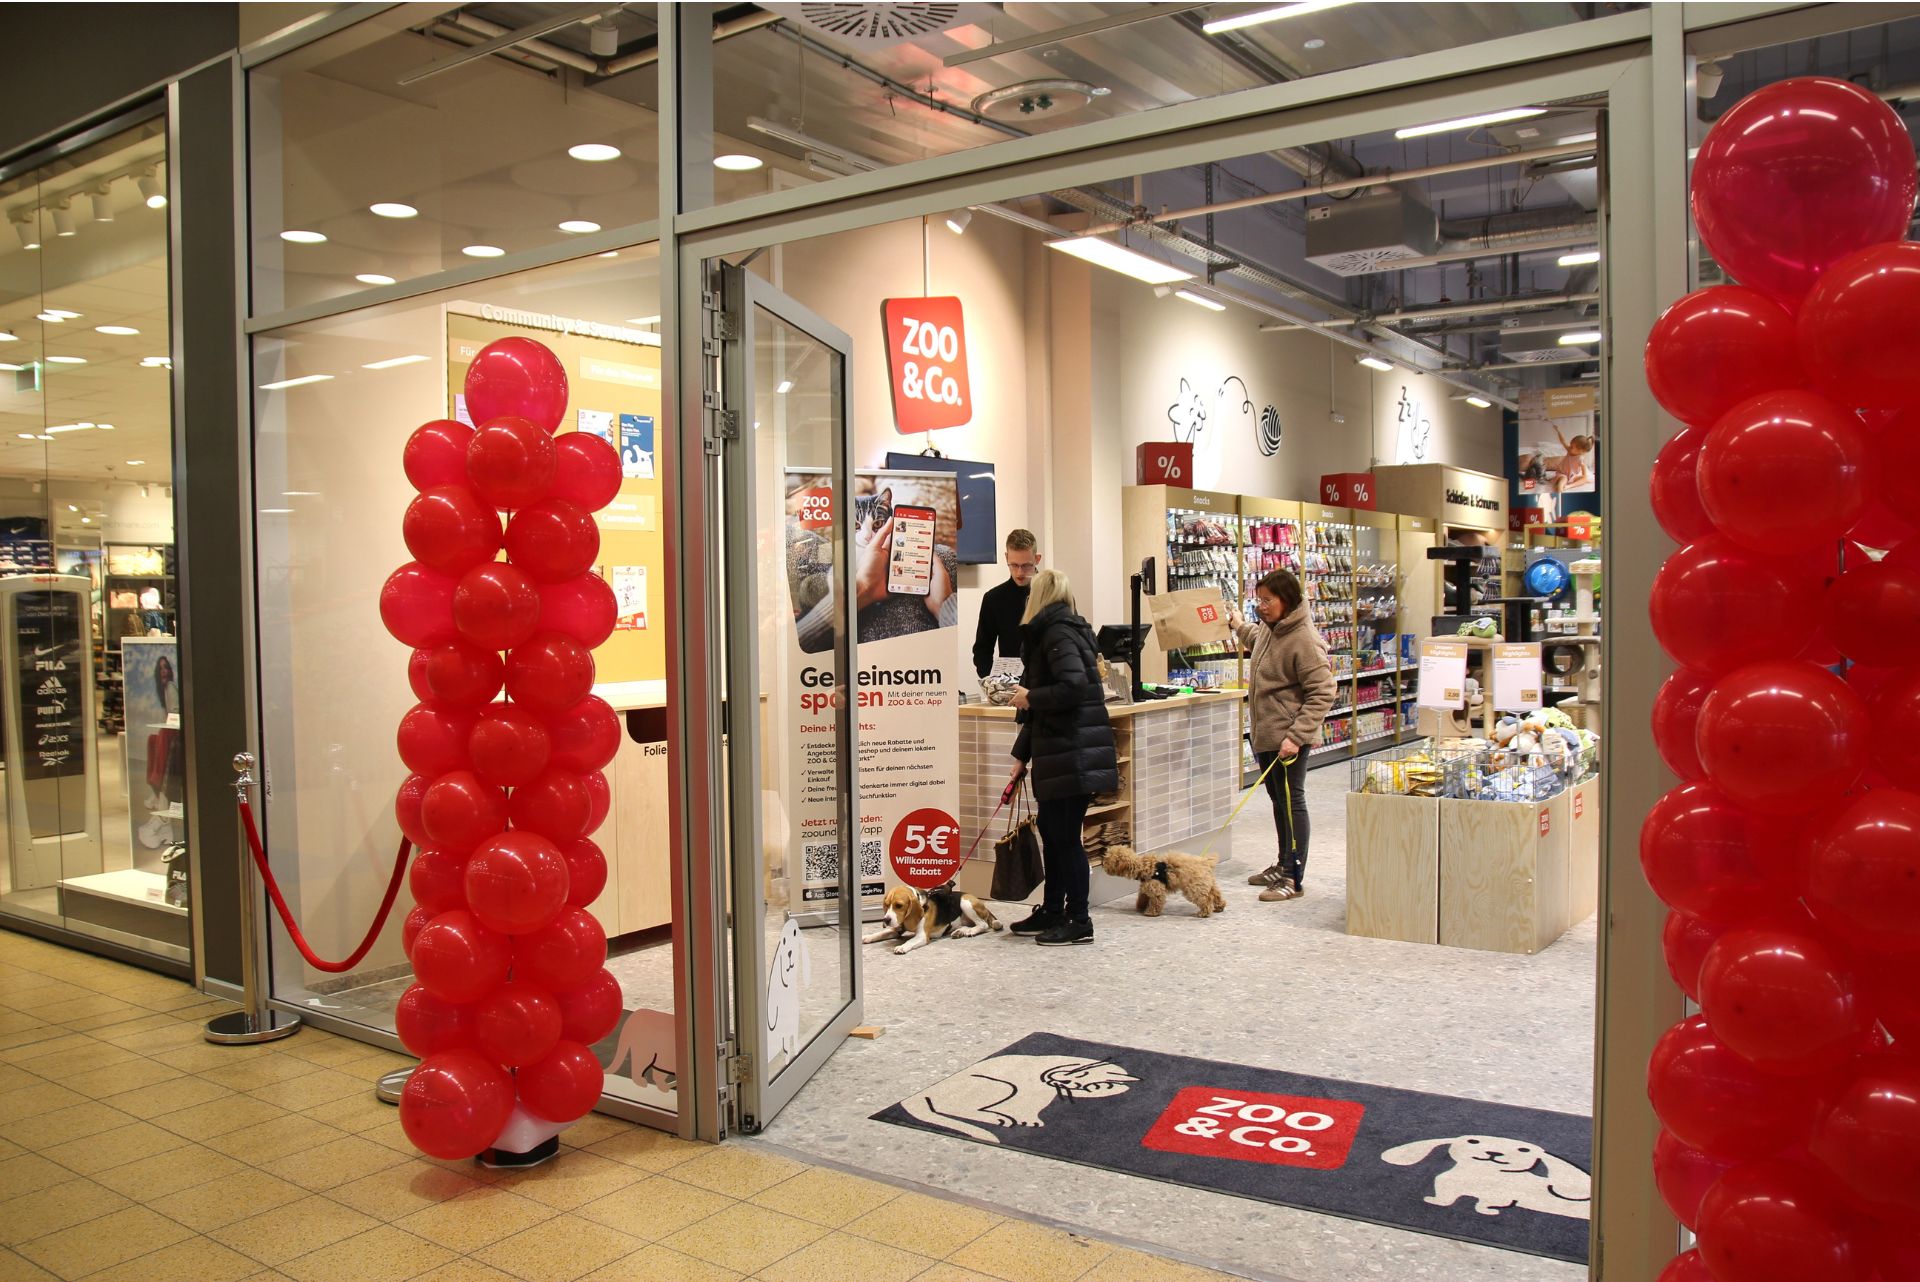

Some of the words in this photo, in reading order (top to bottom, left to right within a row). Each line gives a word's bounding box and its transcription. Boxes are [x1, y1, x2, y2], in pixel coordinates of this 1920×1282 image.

[480, 303, 569, 335] Community
[902, 317, 958, 363] ZOO
[902, 361, 963, 407] &Co.
[1158, 456, 1181, 479] %
[1354, 483, 1369, 502] %
[802, 496, 829, 508] ZOO
[1193, 495, 1210, 505] Snacks
[802, 509, 832, 521] &Co.
[35, 660, 66, 671] FILA
[800, 665, 942, 687] Geeinsam
[800, 691, 883, 715] spen
[927, 698, 942, 707] App
[800, 724, 827, 732] Deine
[644, 744, 667, 757] Folie
[909, 780, 928, 788] digital
[801, 818, 827, 827] Jetzt
[895, 856, 957, 865] Willkommens-
[909, 867, 942, 875] Rabatt
[1196, 1096, 1335, 1131] ZOO
[1174, 1116, 1317, 1157] &Co.
